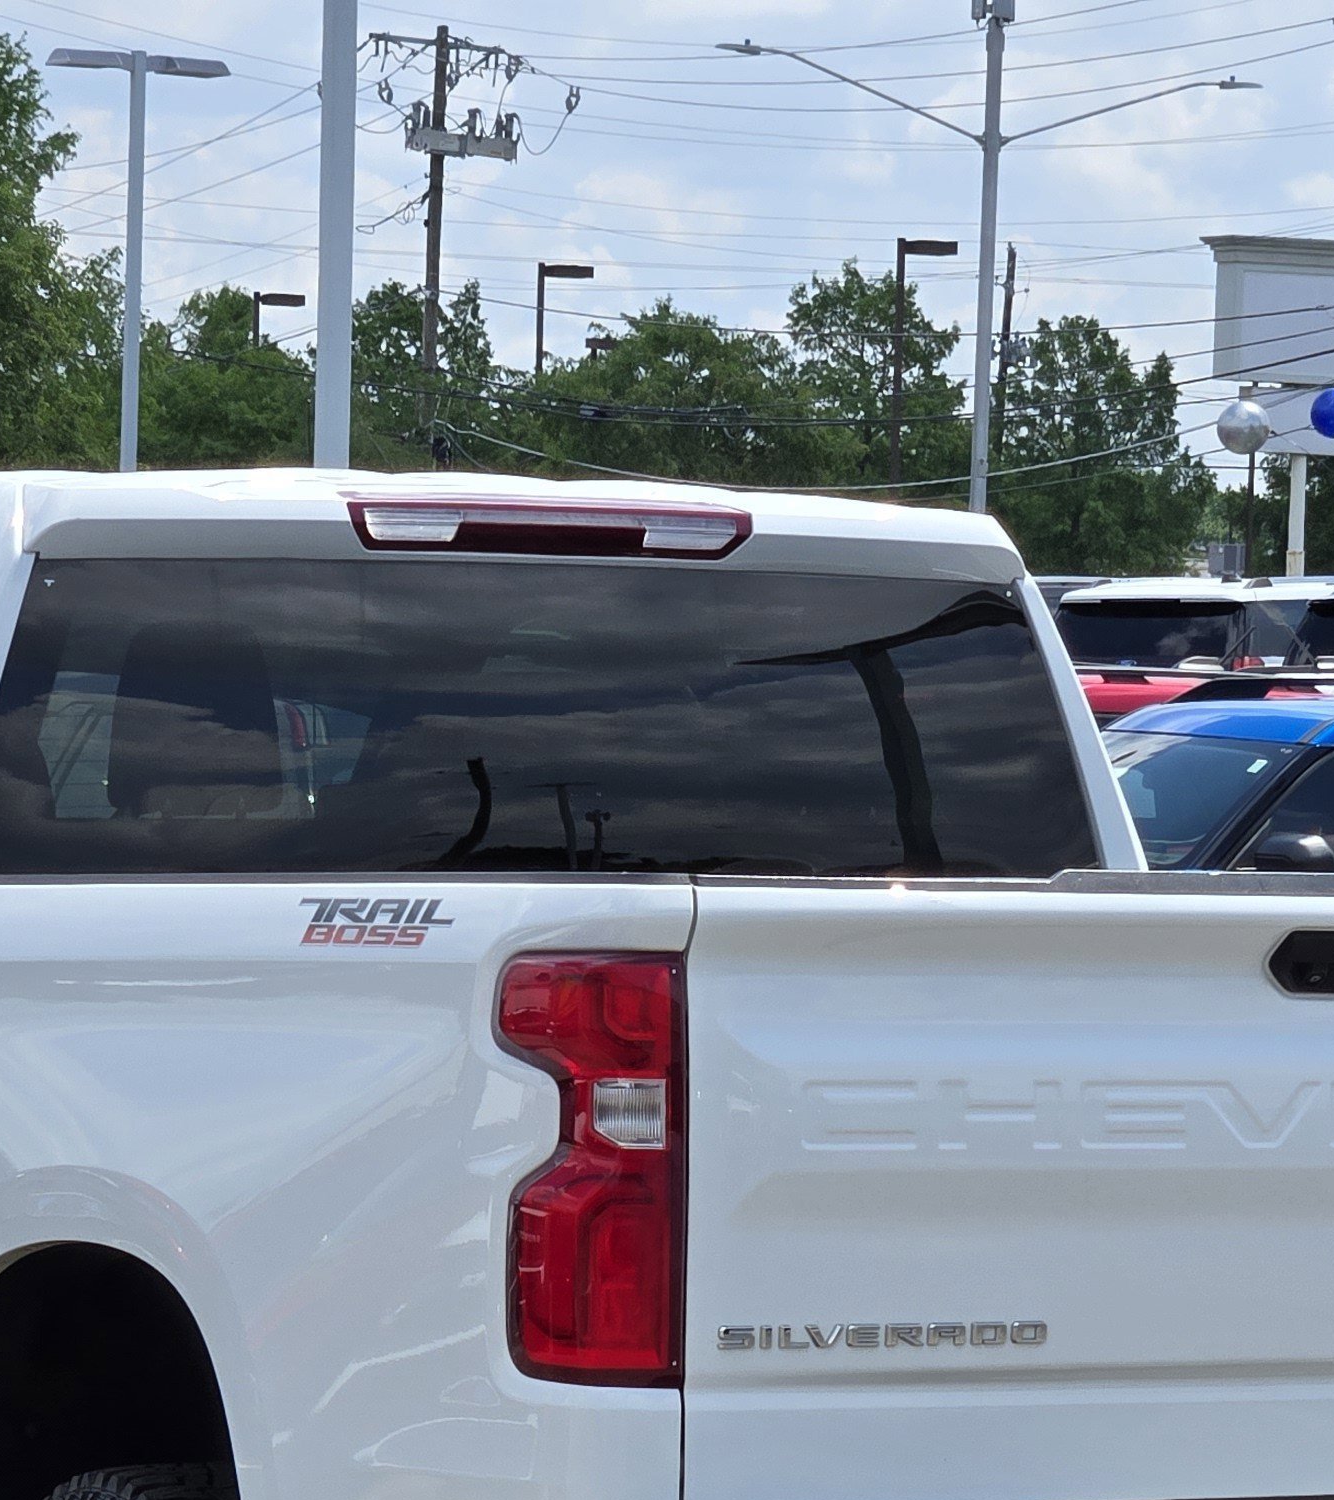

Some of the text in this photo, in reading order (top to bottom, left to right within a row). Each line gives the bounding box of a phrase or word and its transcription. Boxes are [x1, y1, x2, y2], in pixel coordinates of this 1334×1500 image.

[299, 897, 456, 927] TRAIL
[299, 924, 430, 949] BOSS
[717, 1320, 1048, 1350] SILVERADO
